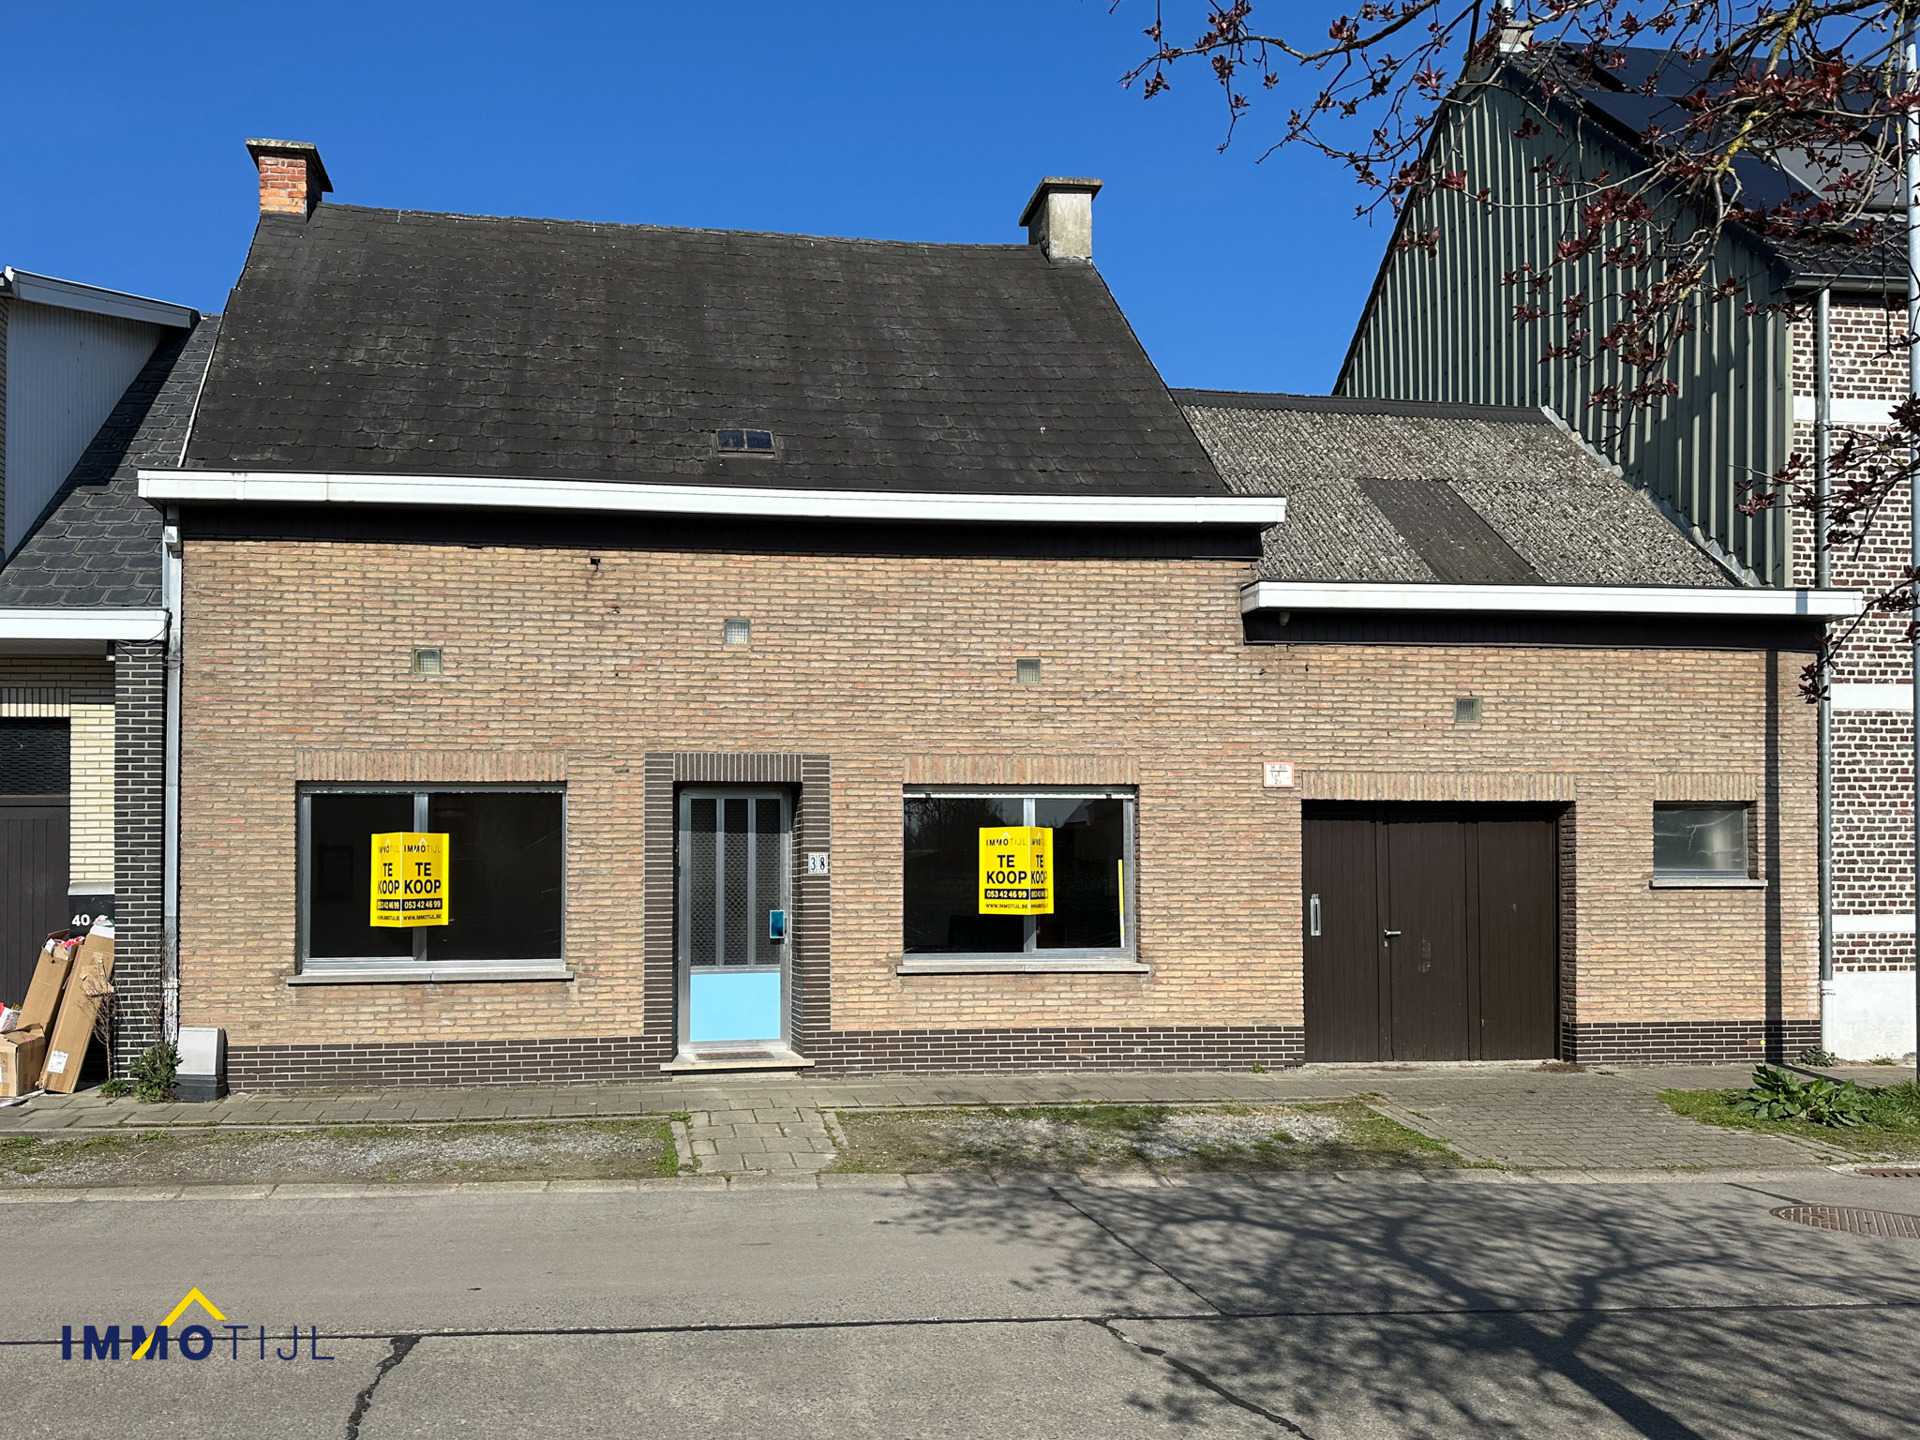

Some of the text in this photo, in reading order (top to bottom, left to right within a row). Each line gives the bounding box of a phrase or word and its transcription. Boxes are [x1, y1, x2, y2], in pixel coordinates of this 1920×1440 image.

[811, 857, 825, 871] 38
[997, 855, 1015, 868] TE
[1036, 855, 1044, 868] TE
[383, 863, 393, 877] TE
[415, 862, 431, 876] TE
[987, 871, 1027, 884] KOOP
[378, 880, 400, 894] KOOP
[404, 879, 441, 894] KOOP
[71, 914, 90, 927] 40
